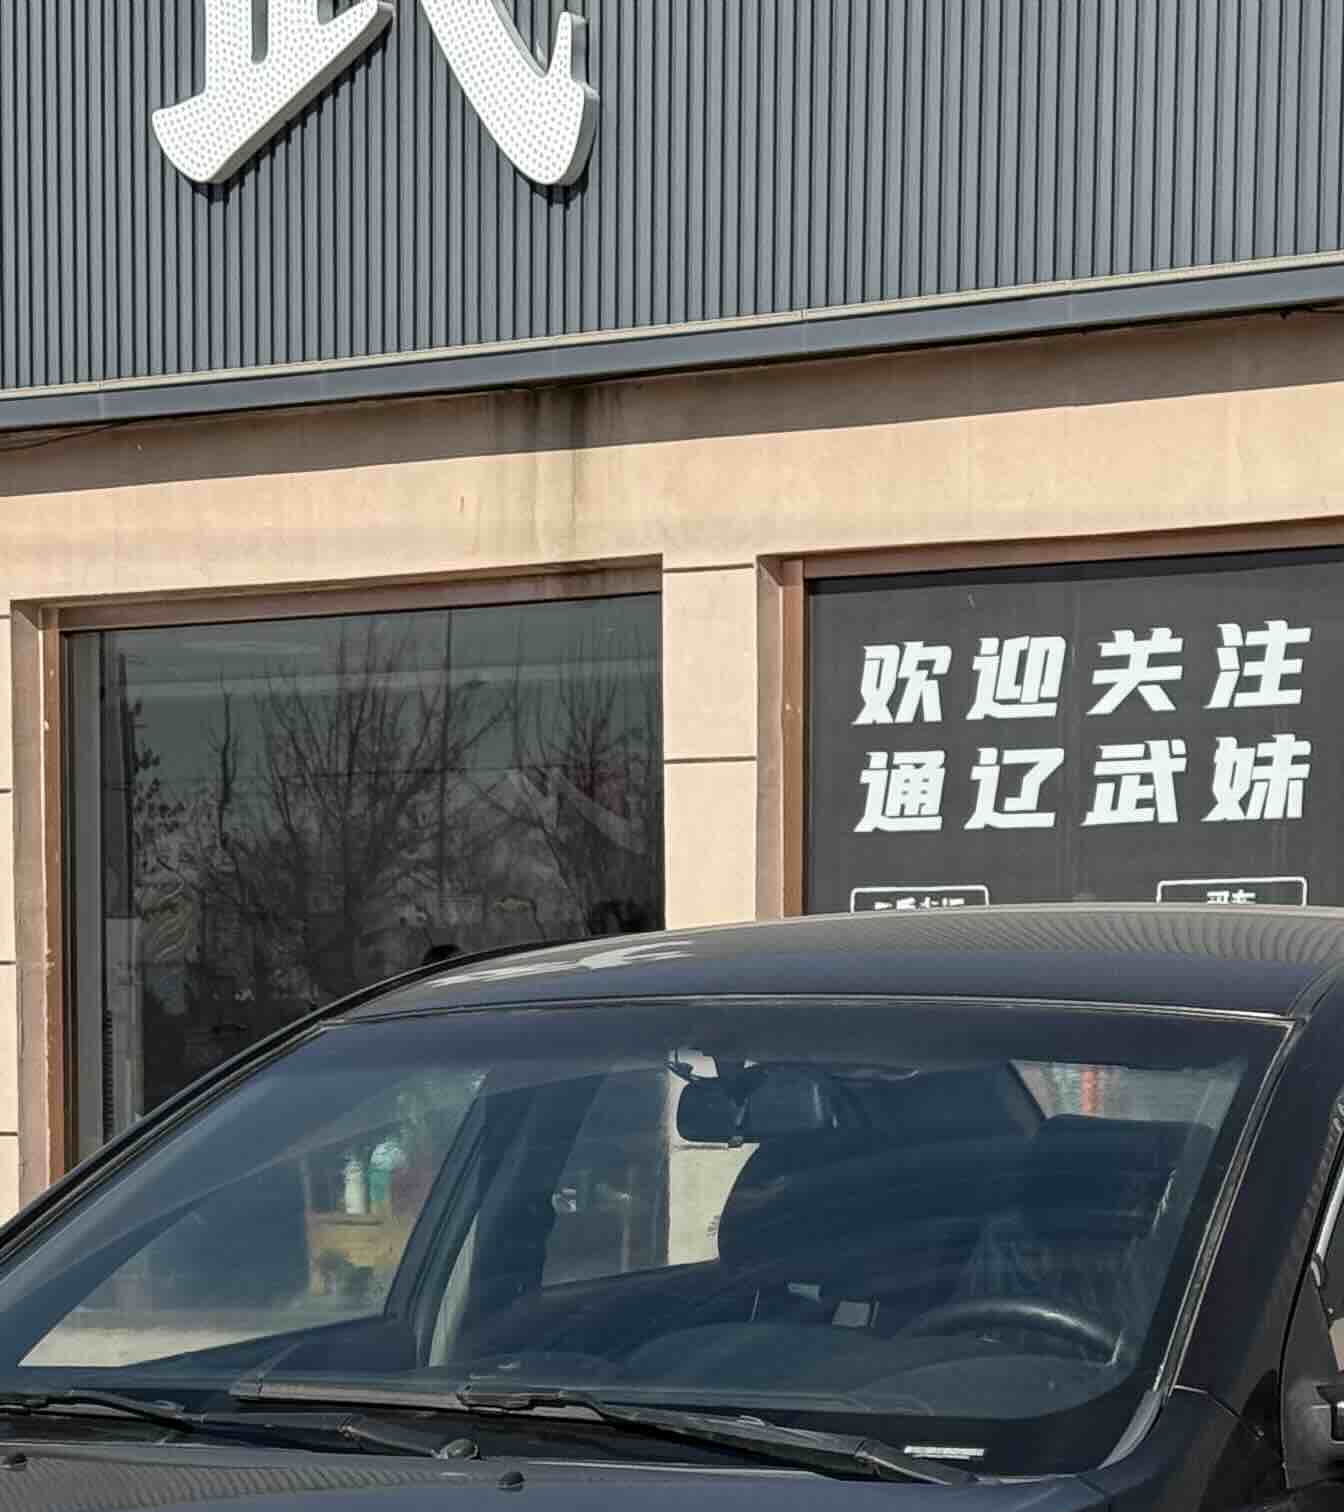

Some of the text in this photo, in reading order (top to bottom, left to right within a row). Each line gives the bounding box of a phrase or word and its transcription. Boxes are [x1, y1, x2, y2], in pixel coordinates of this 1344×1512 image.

[852, 619, 1312, 726] 欢迎关注
[853, 733, 1312, 833] 通辽武妹
